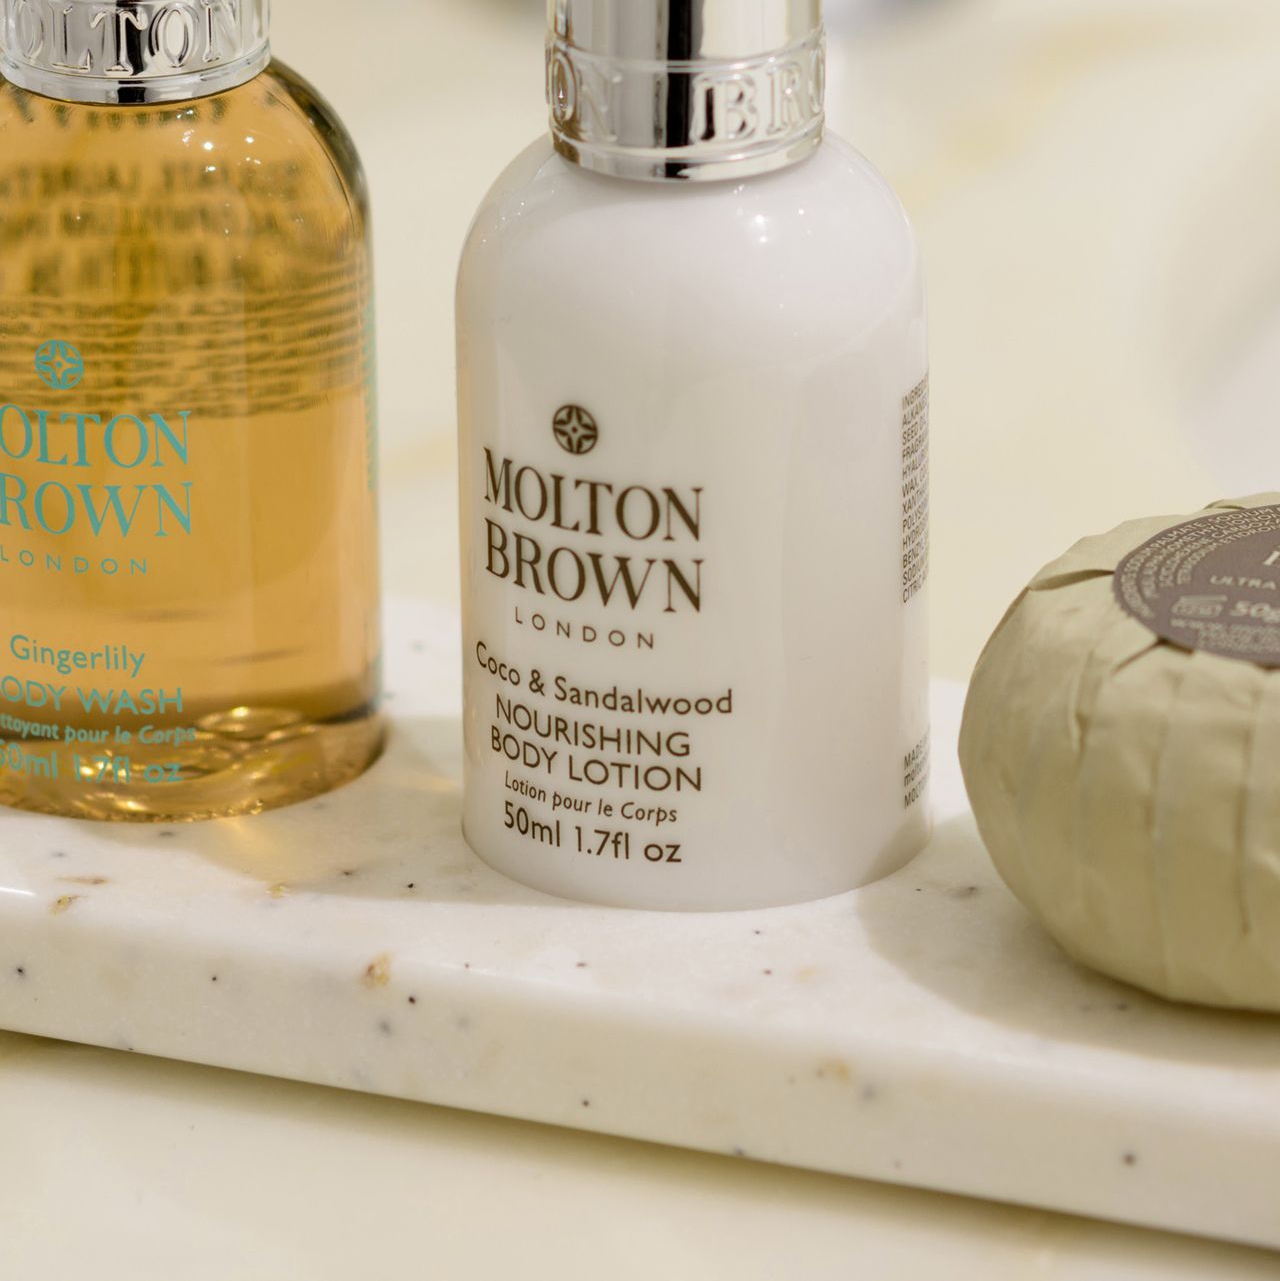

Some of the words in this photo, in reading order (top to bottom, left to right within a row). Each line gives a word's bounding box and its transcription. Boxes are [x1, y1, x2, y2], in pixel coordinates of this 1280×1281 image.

[483, 446, 704, 542] MOLTON
[0, 543, 148, 576] LONDON
[484, 518, 705, 614] BROWN
[1210, 575, 1277, 591] ULTRA
[514, 606, 655, 650] LONDON
[9, 633, 147, 678] Gingerlily
[475, 640, 521, 687] Coco
[528, 668, 545, 697] &
[553, 675, 733, 715] Sandalwood
[76, 685, 184, 715] WASH
[495, 693, 691, 758] NOURISHING
[64, 724, 110, 747] pour
[114, 725, 133, 745] le
[138, 724, 197, 748] Corps
[490, 725, 558, 775] BODY
[568, 755, 703, 793] LOTION
[73, 755, 131, 784] 1.7fl
[144, 762, 184, 784] oz
[504, 769, 547, 805] Lotion
[552, 790, 593, 814] pour
[597, 797, 614, 818] le
[620, 801, 678, 827] Corps
[503, 800, 561, 848] 50ml
[573, 824, 631, 861] 1.7fl
[643, 841, 683, 864] oz
